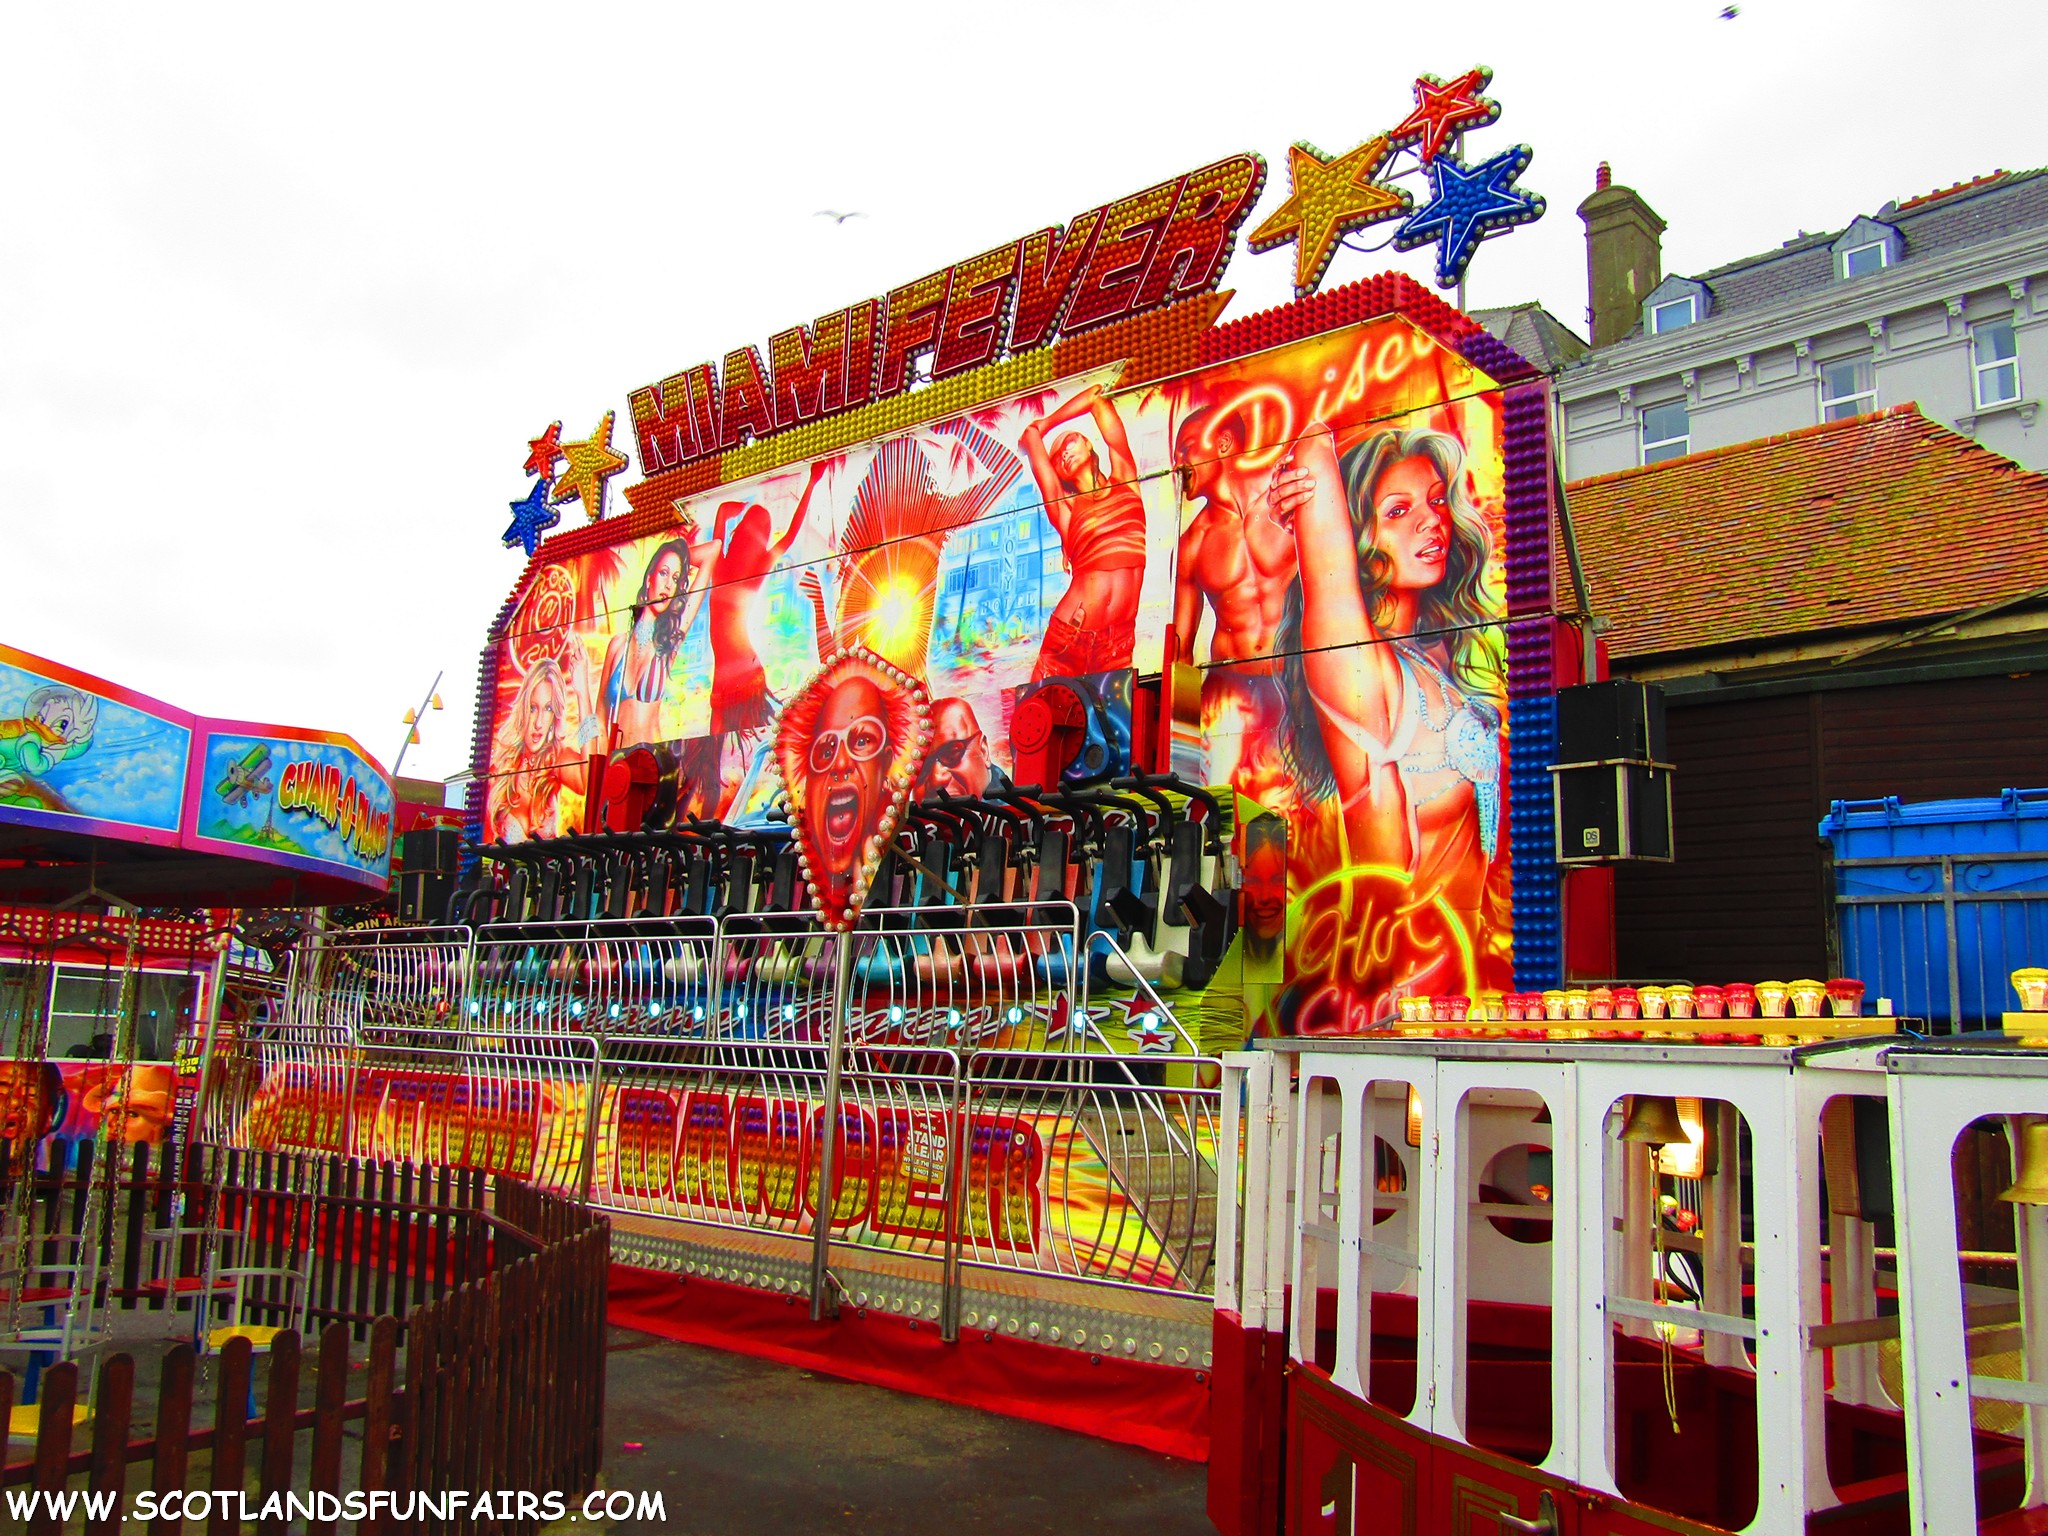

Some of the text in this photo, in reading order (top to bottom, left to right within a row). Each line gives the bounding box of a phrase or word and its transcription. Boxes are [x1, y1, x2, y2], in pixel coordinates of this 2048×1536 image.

[627, 150, 1268, 478] MIAMI FEVER
[1202, 331, 1436, 470] Disco
[347, 917, 380, 937] SPIN
[1298, 884, 1443, 983] Hot
[907, 1129, 946, 1149] STAND
[902, 1155, 920, 1167] WHLE
[905, 1142, 945, 1162] CLEAR
[613, 1087, 1043, 1255] DANCER
[917, 1168, 939, 1179] MOTON
